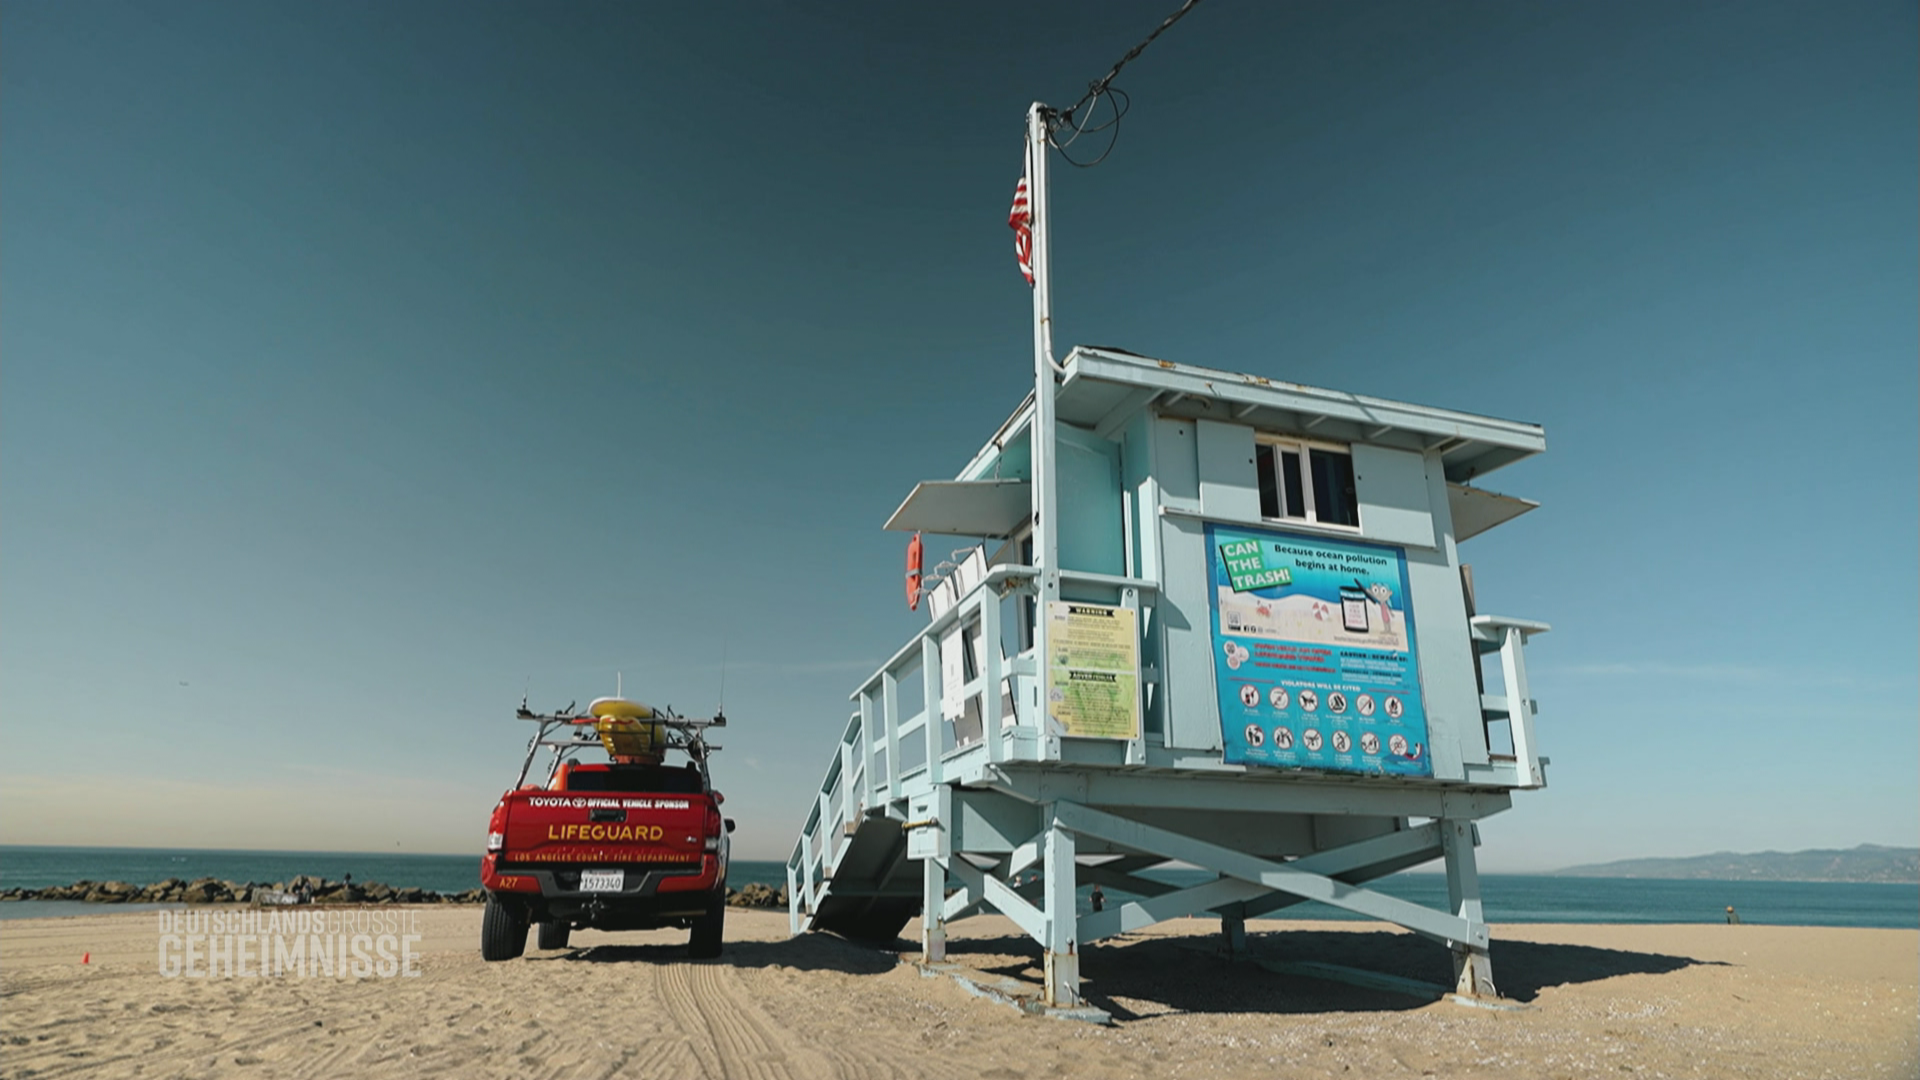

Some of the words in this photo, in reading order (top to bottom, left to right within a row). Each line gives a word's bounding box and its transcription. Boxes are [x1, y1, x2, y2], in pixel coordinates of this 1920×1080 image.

[1224, 541, 1259, 556] CAN
[1274, 544, 1314, 557] Because
[1316, 551, 1344, 561] ocean
[1346, 552, 1388, 566] pollution
[1229, 557, 1262, 572] THE
[1295, 559, 1326, 571] begins
[1340, 563, 1370, 575] home.
[1233, 569, 1291, 588] TRASH!
[1076, 606, 1107, 616] WARNING
[1281, 680, 1315, 689] VIOLATORS
[528, 797, 571, 807] TOYOTA
[587, 798, 620, 808] OFFICIAL
[622, 799, 652, 809] VEHICLE
[654, 800, 689, 809] SPONSOR
[548, 824, 663, 841] LIFEGUARD
[515, 853, 531, 862] LOS
[535, 853, 571, 862] ANGELES
[576, 853, 609, 862] COUNTY
[614, 853, 632, 862] FIRE
[637, 853, 690, 862] DEPARTMENT
[500, 877, 518, 889] A27
